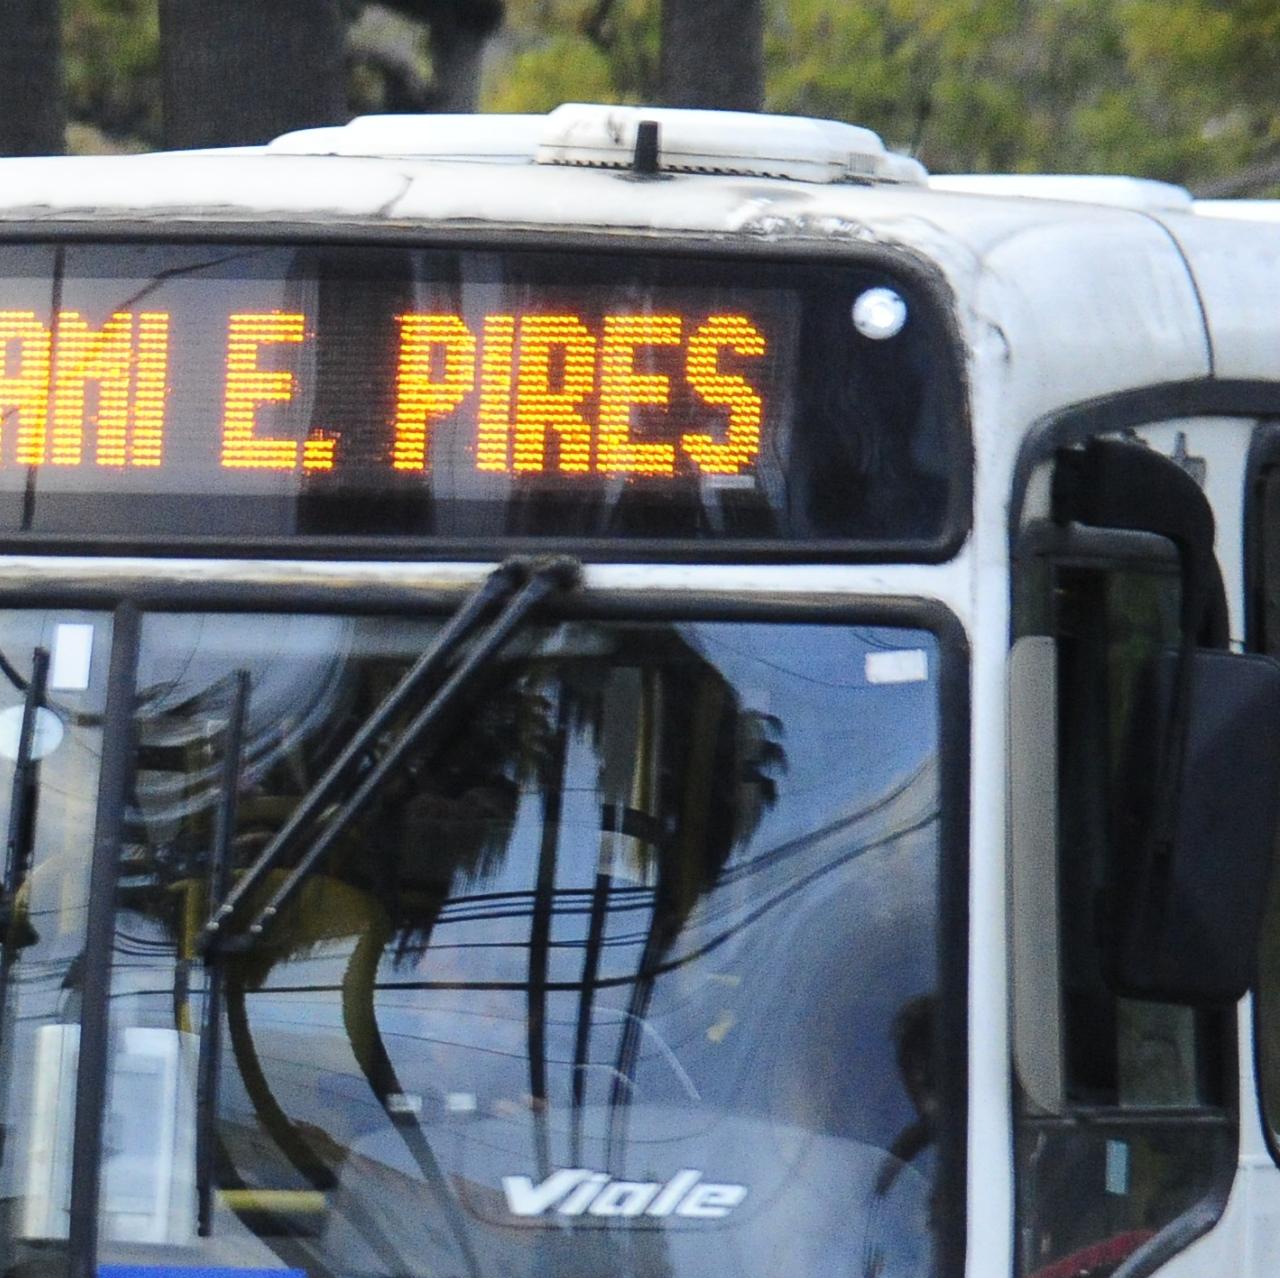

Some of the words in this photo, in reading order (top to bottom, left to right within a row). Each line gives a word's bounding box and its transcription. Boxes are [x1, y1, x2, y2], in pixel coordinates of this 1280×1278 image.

[221, 312, 336, 469] E.
[392, 313, 767, 474] PIRES
[502, 1168, 747, 1217] Viale
